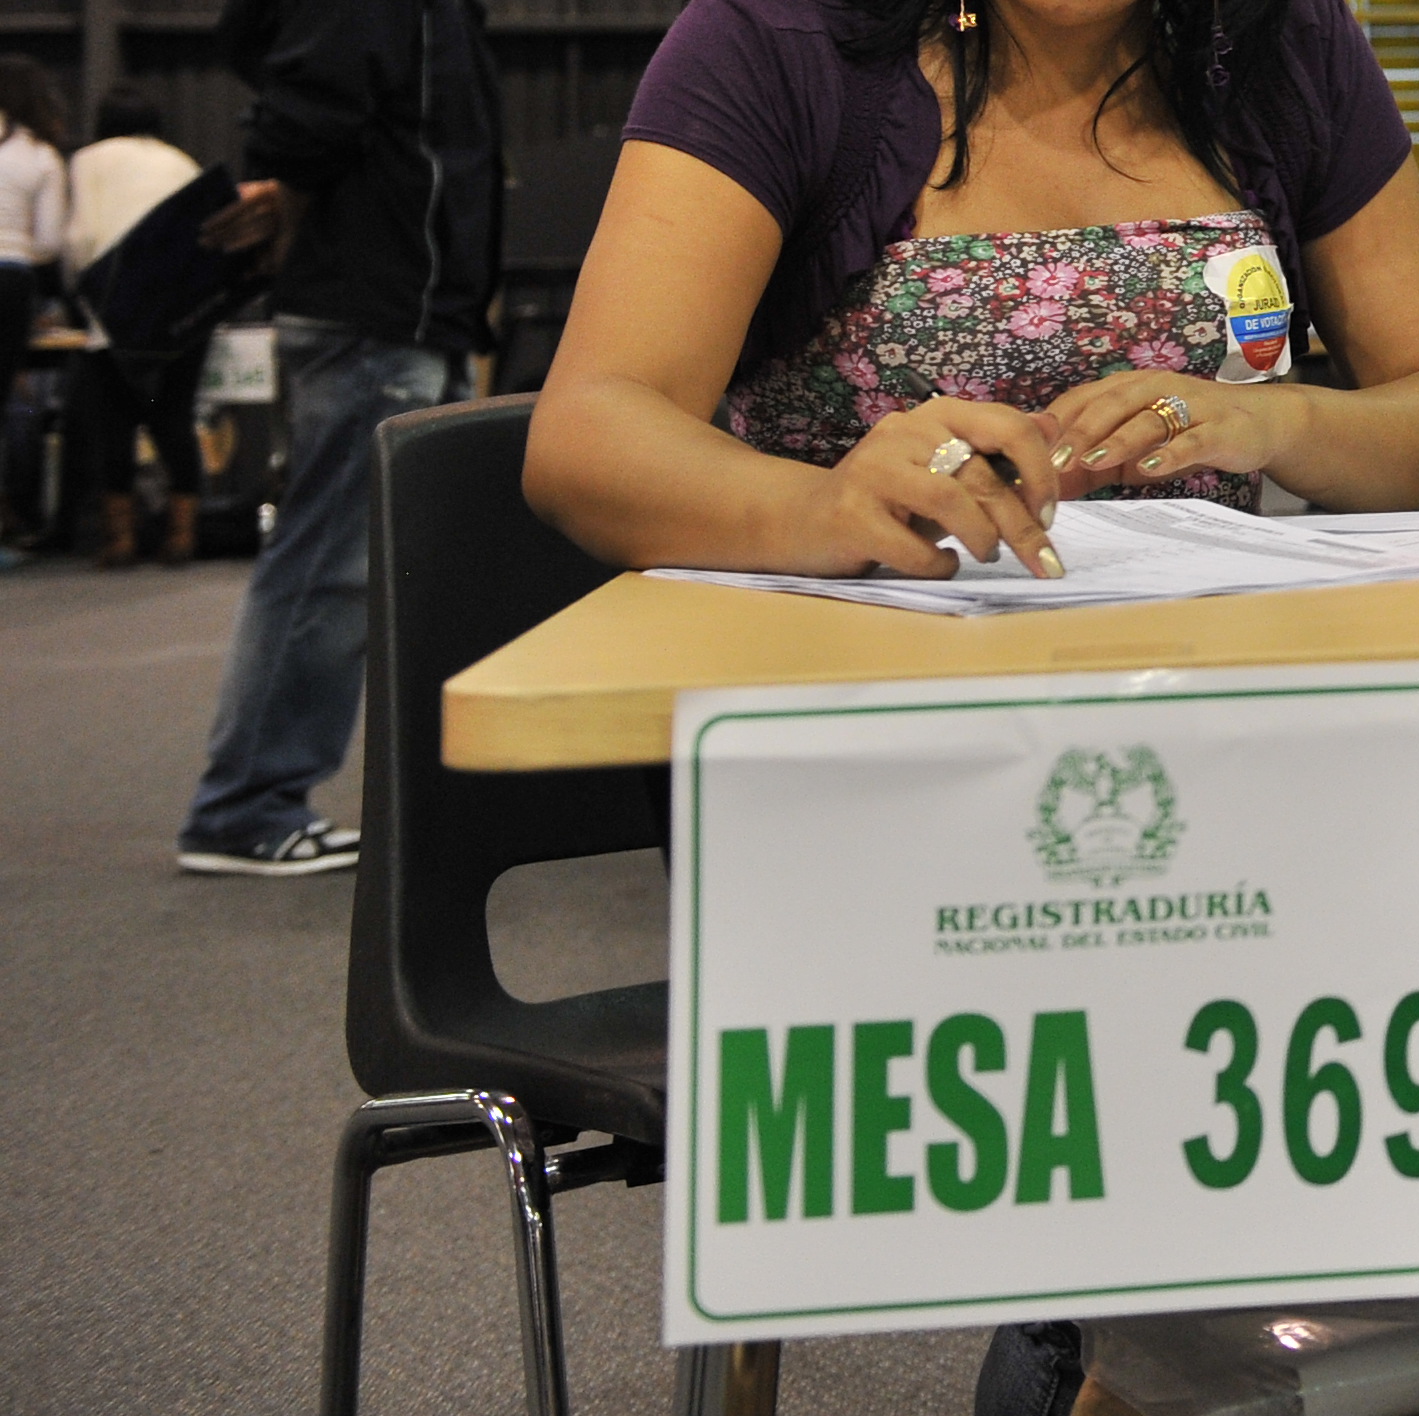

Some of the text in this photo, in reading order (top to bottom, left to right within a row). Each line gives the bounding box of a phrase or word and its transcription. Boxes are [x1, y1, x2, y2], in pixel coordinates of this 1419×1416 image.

[1245, 319, 1259, 330] DE
[935, 880, 1274, 932] REGISTRADURÍA
[934, 920, 1273, 955] NACIONAL DEL ESTADO CIVIL
[715, 1010, 1106, 1225] MESA
